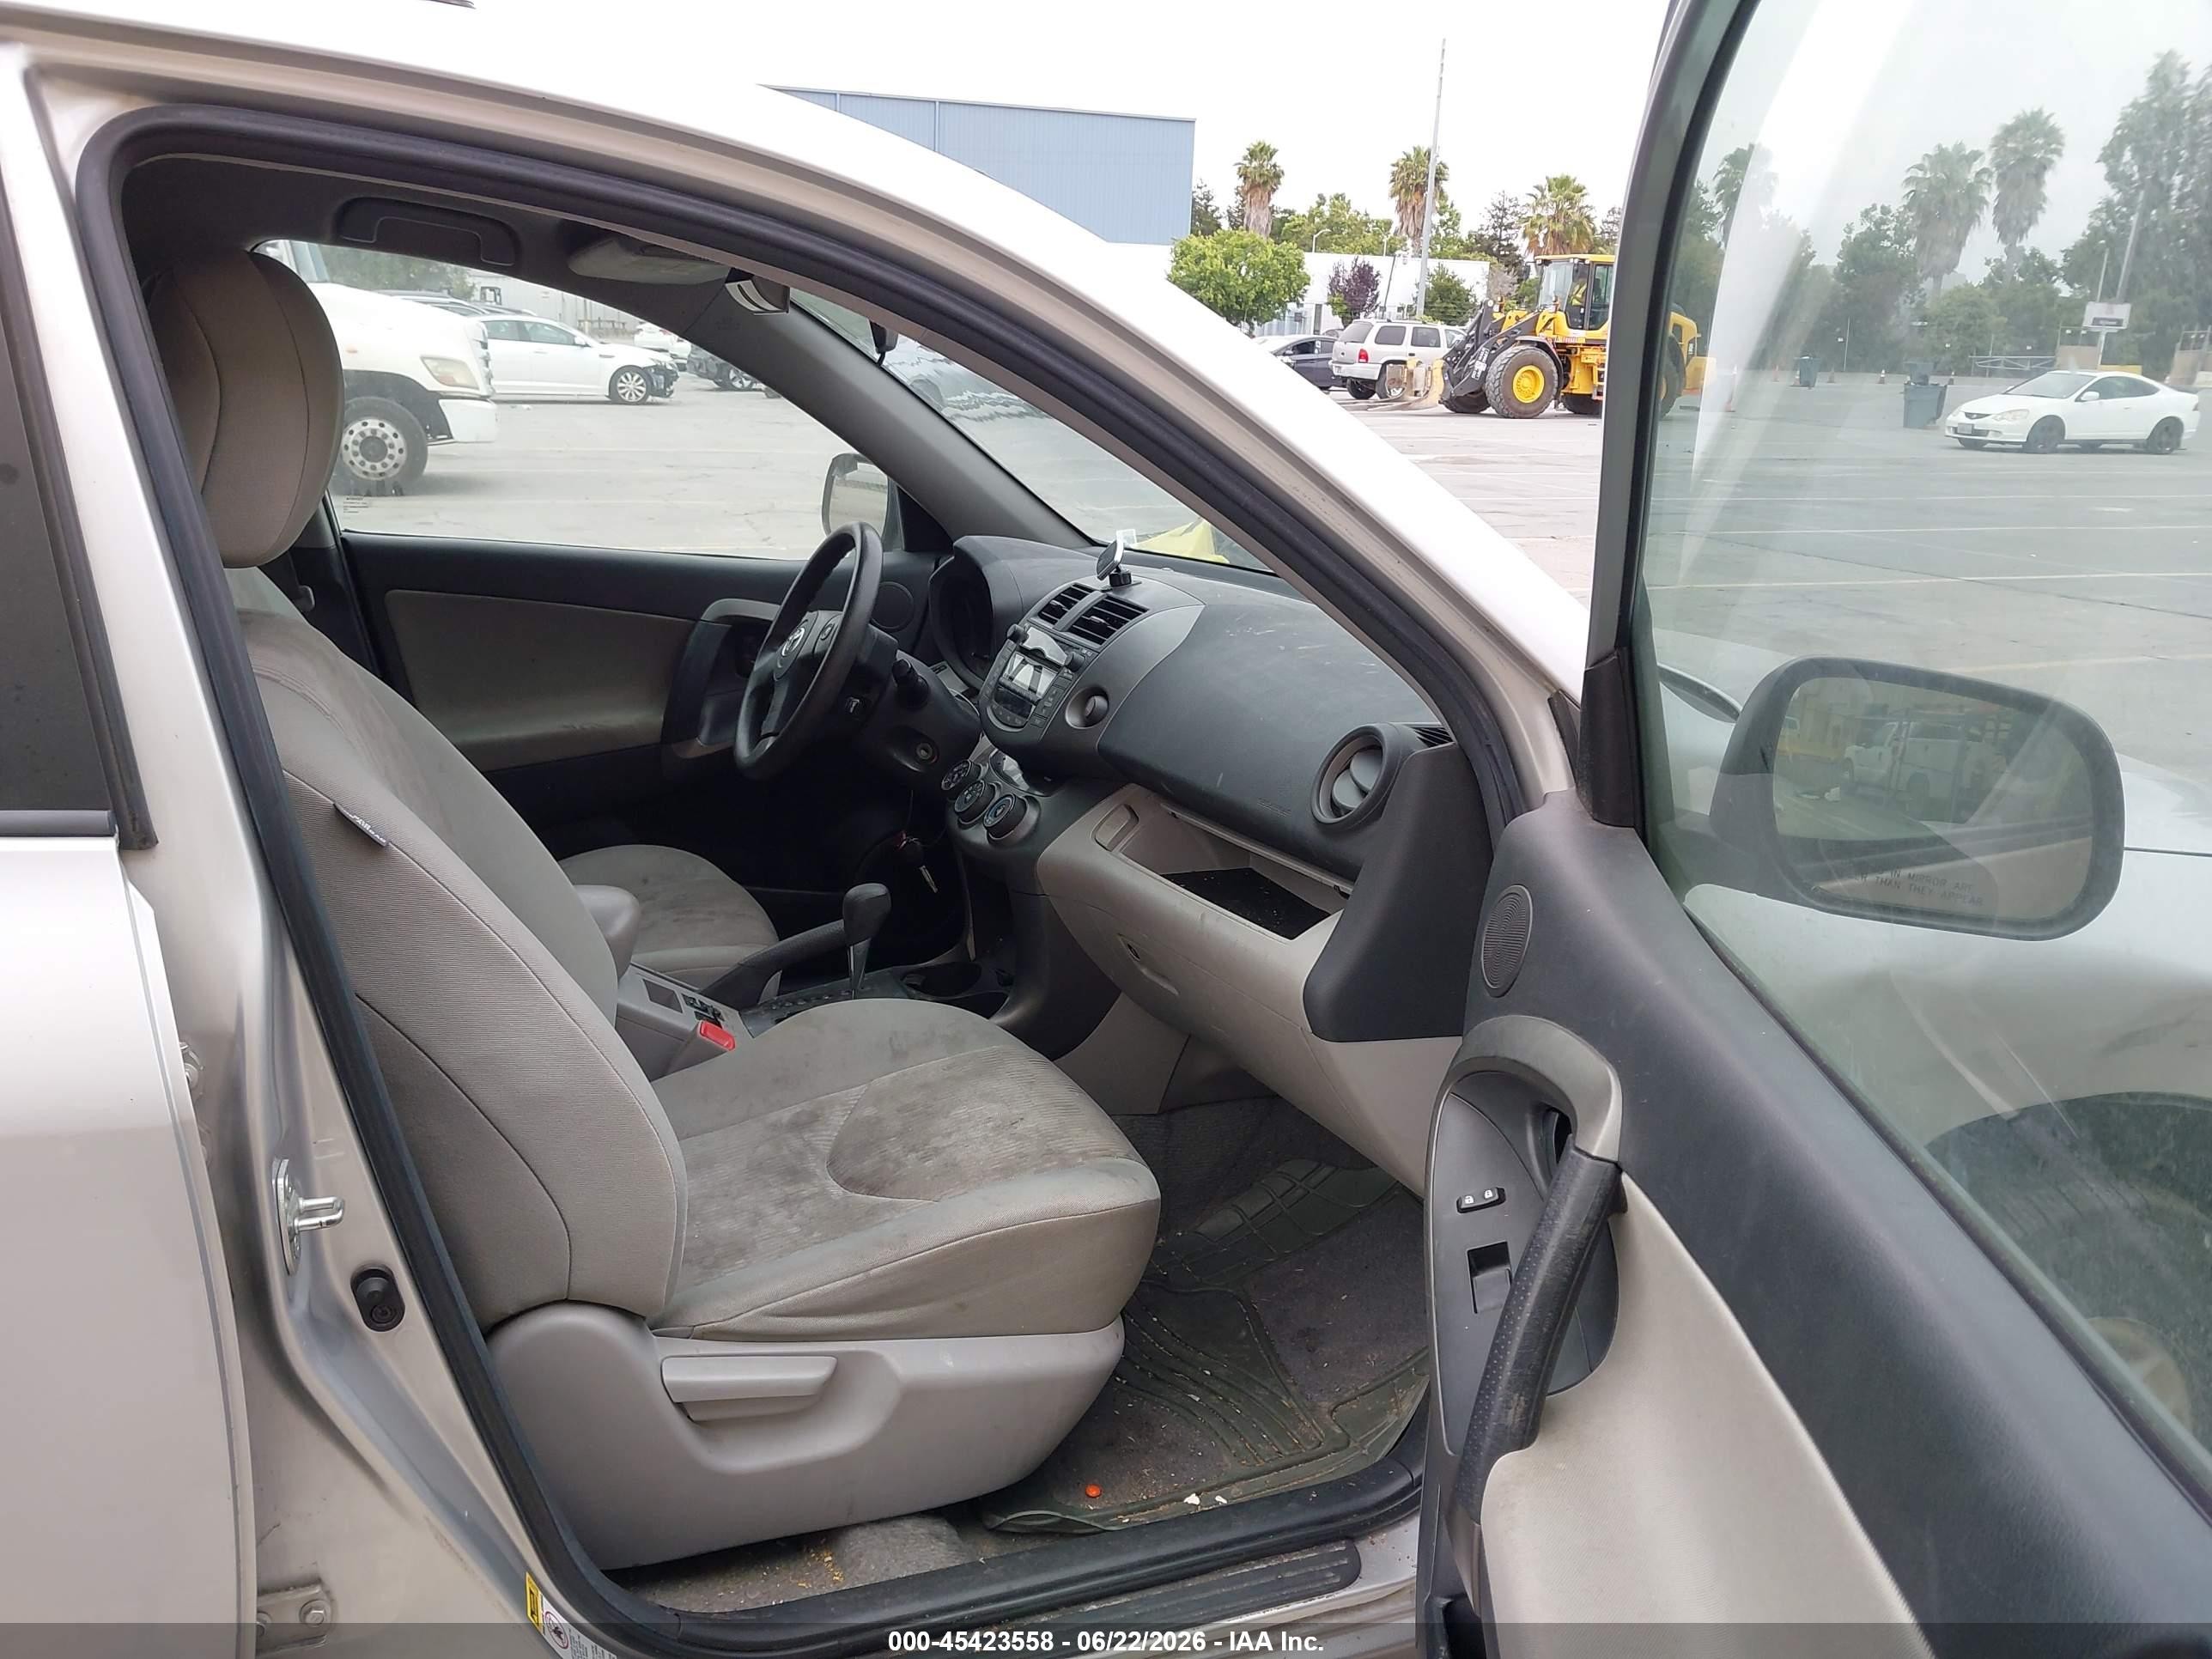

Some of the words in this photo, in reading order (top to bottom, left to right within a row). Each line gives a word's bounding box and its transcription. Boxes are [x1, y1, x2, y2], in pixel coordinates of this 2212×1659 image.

[1875, 876, 1902, 890] THAN
[1909, 883, 1934, 896] THEY
[1907, 872, 1948, 887] MIRROR
